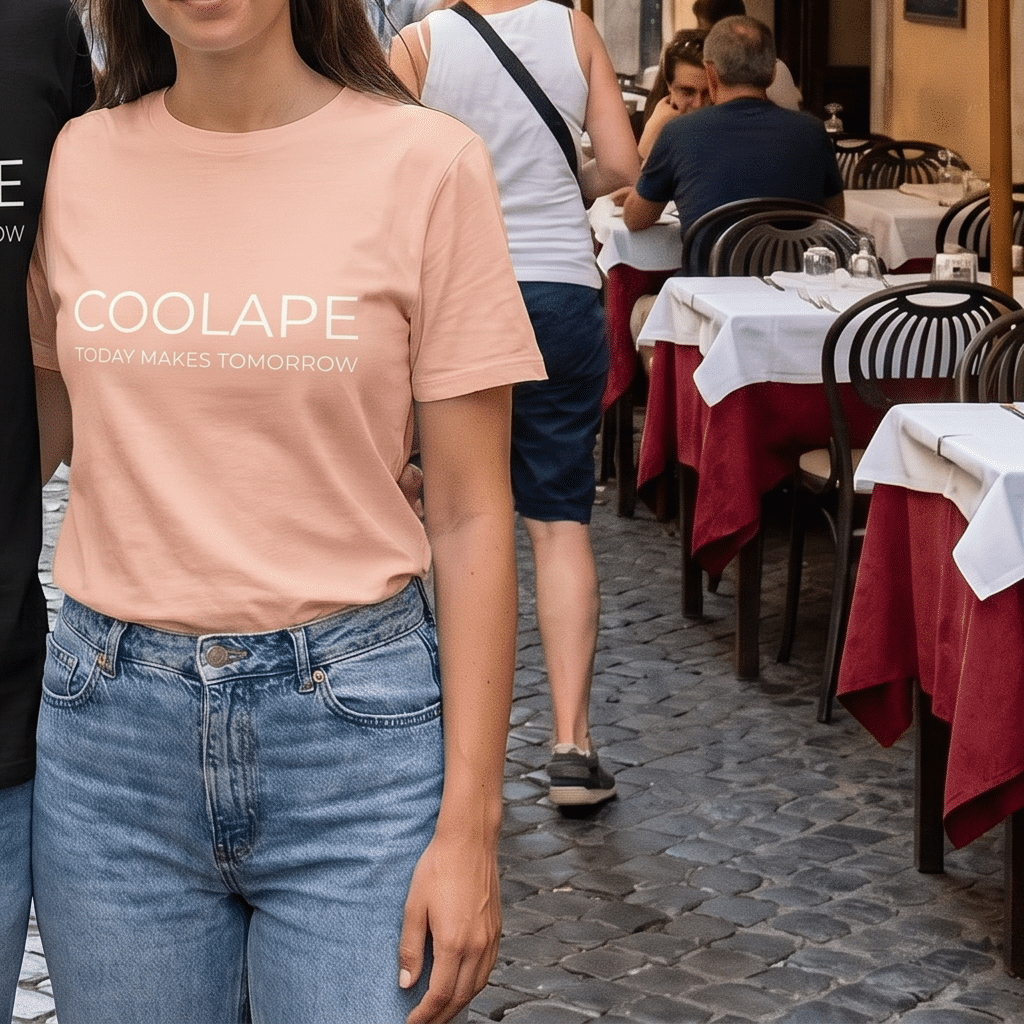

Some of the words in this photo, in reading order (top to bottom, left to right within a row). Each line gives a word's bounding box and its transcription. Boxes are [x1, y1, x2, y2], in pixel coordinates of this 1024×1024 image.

[73, 289, 359, 341] COOLAPE
[74, 346, 136, 364] TODAY
[141, 349, 212, 369] MAKES
[217, 352, 359, 374] TOMORROW
